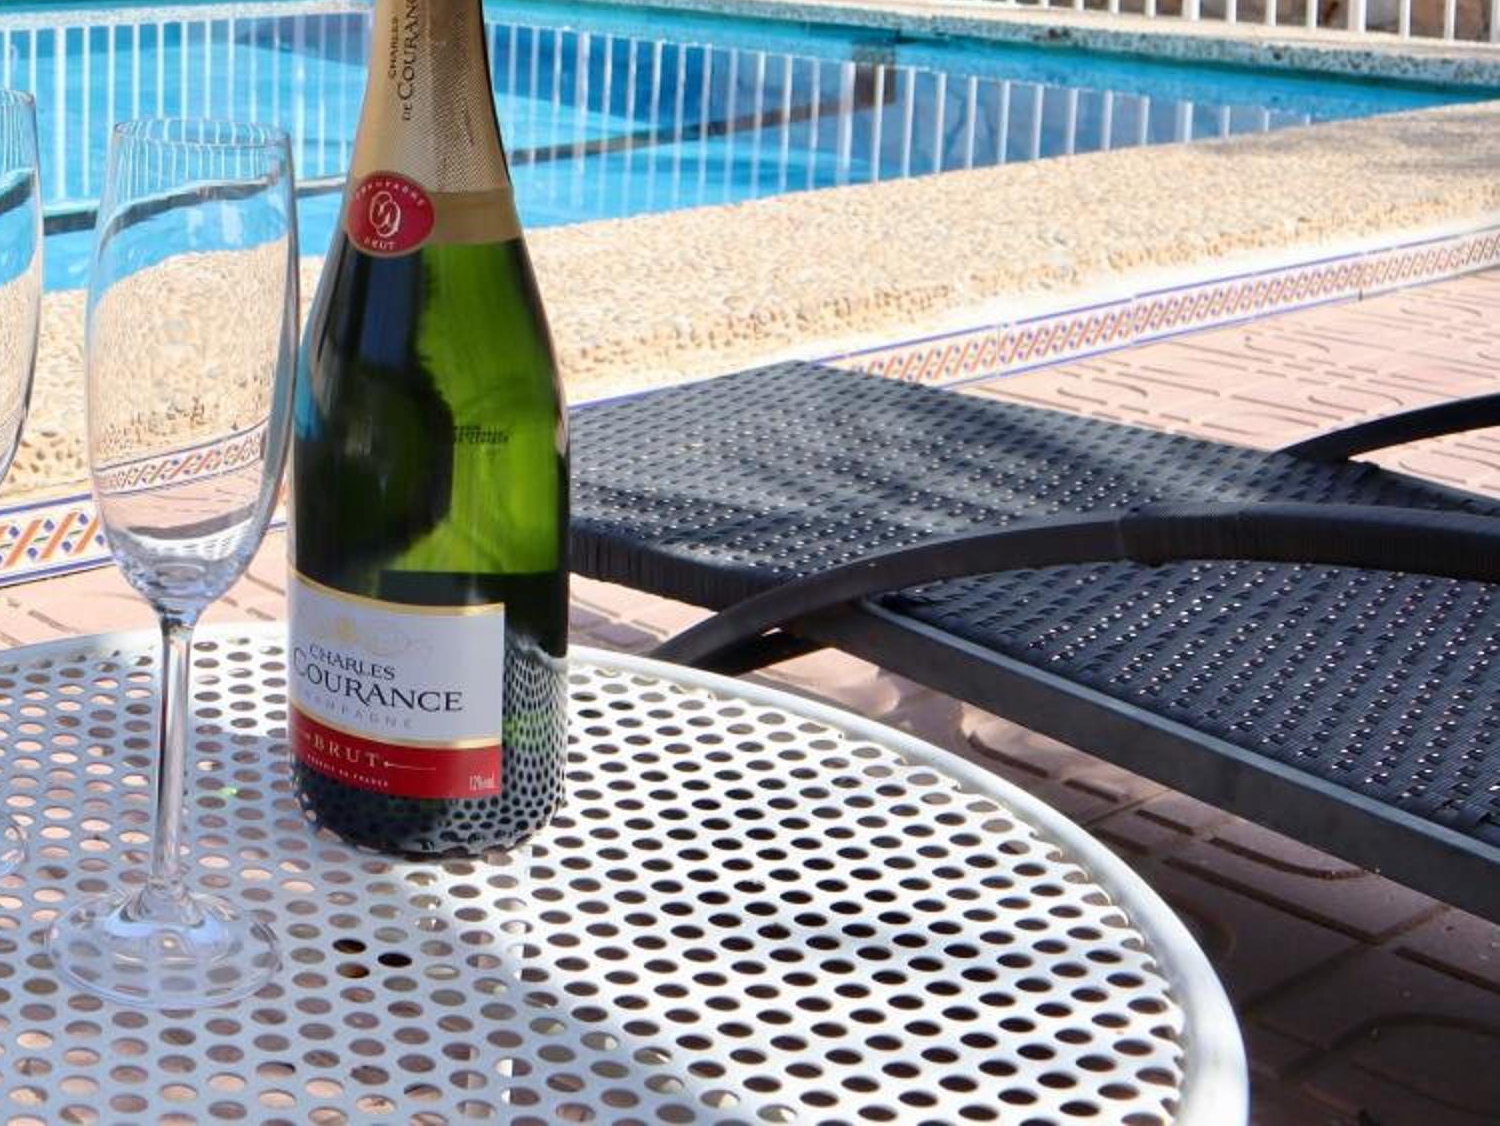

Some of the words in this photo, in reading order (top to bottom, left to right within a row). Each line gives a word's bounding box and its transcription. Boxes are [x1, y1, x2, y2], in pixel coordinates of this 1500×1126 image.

[293, 647, 464, 712] COURANCE
[309, 643, 396, 681] CHARLES
[313, 732, 380, 769] BRUT
